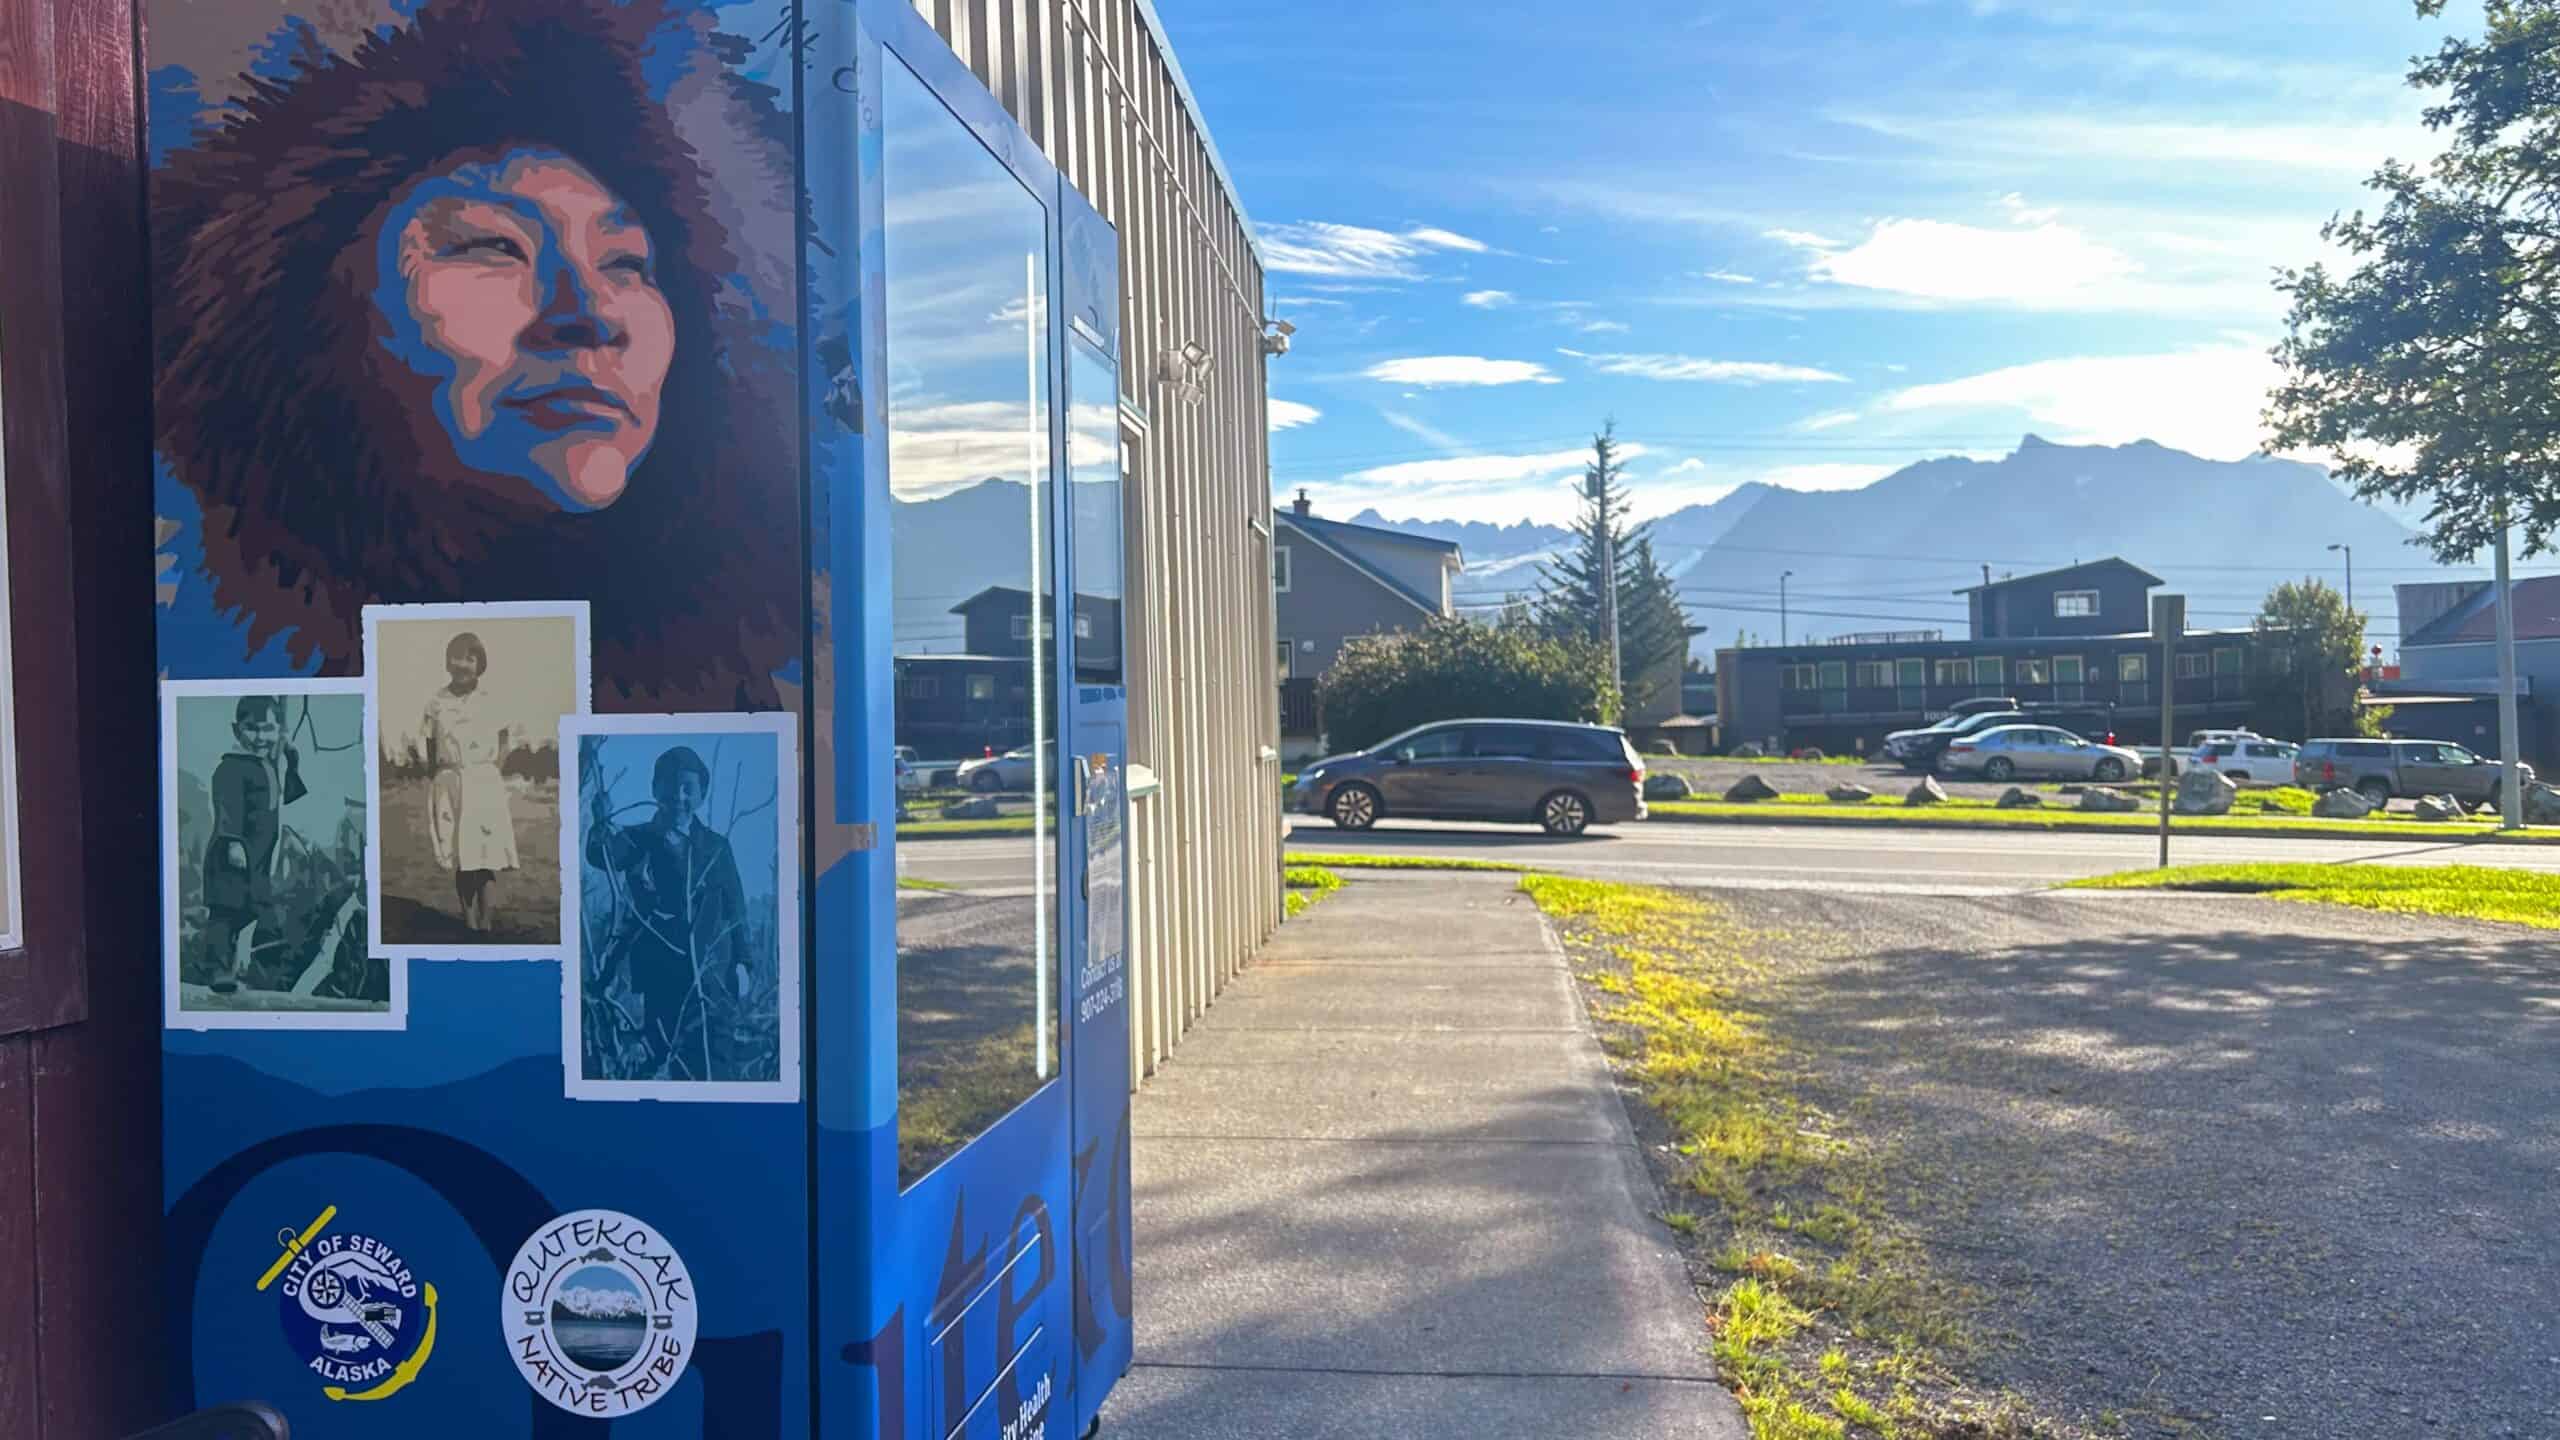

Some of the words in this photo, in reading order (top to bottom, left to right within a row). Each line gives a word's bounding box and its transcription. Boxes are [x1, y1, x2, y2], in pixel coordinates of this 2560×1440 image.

[283, 1250, 314, 1297] CITY
[317, 1235, 343, 1256] OF
[350, 1235, 417, 1299] SEWARD
[512, 1219, 689, 1311] QUTEKCAK
[309, 1356, 392, 1382] ALASKA
[517, 1334, 608, 1412] NATIVE
[614, 1335, 681, 1410] TRIBE
[1019, 1372, 1050, 1434] Health
